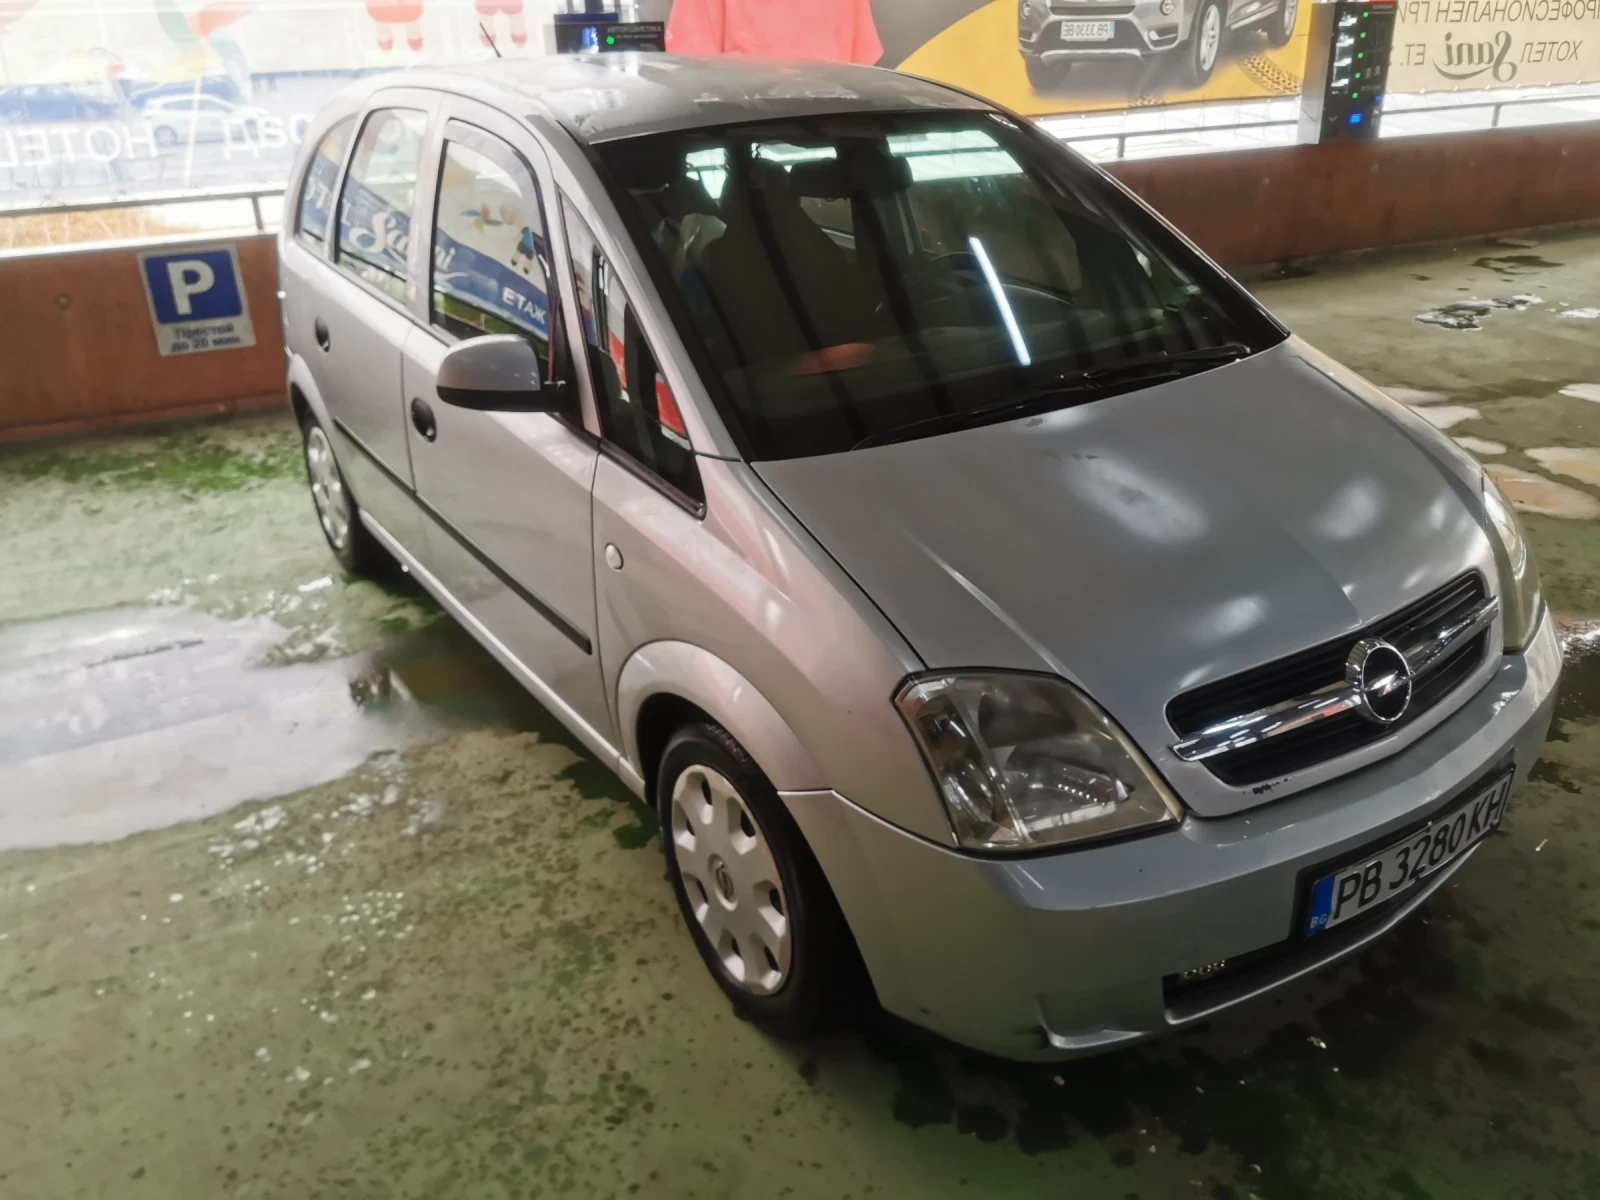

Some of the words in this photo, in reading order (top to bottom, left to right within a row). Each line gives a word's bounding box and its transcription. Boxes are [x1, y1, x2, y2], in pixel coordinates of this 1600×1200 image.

[167, 259, 215, 316] P
[502, 286, 547, 325] ЕТАЖ
[1333, 860, 1383, 920] PB
[1389, 813, 1467, 890] 3280
[1466, 781, 1508, 842] KH
[1310, 913, 1328, 929] BG
